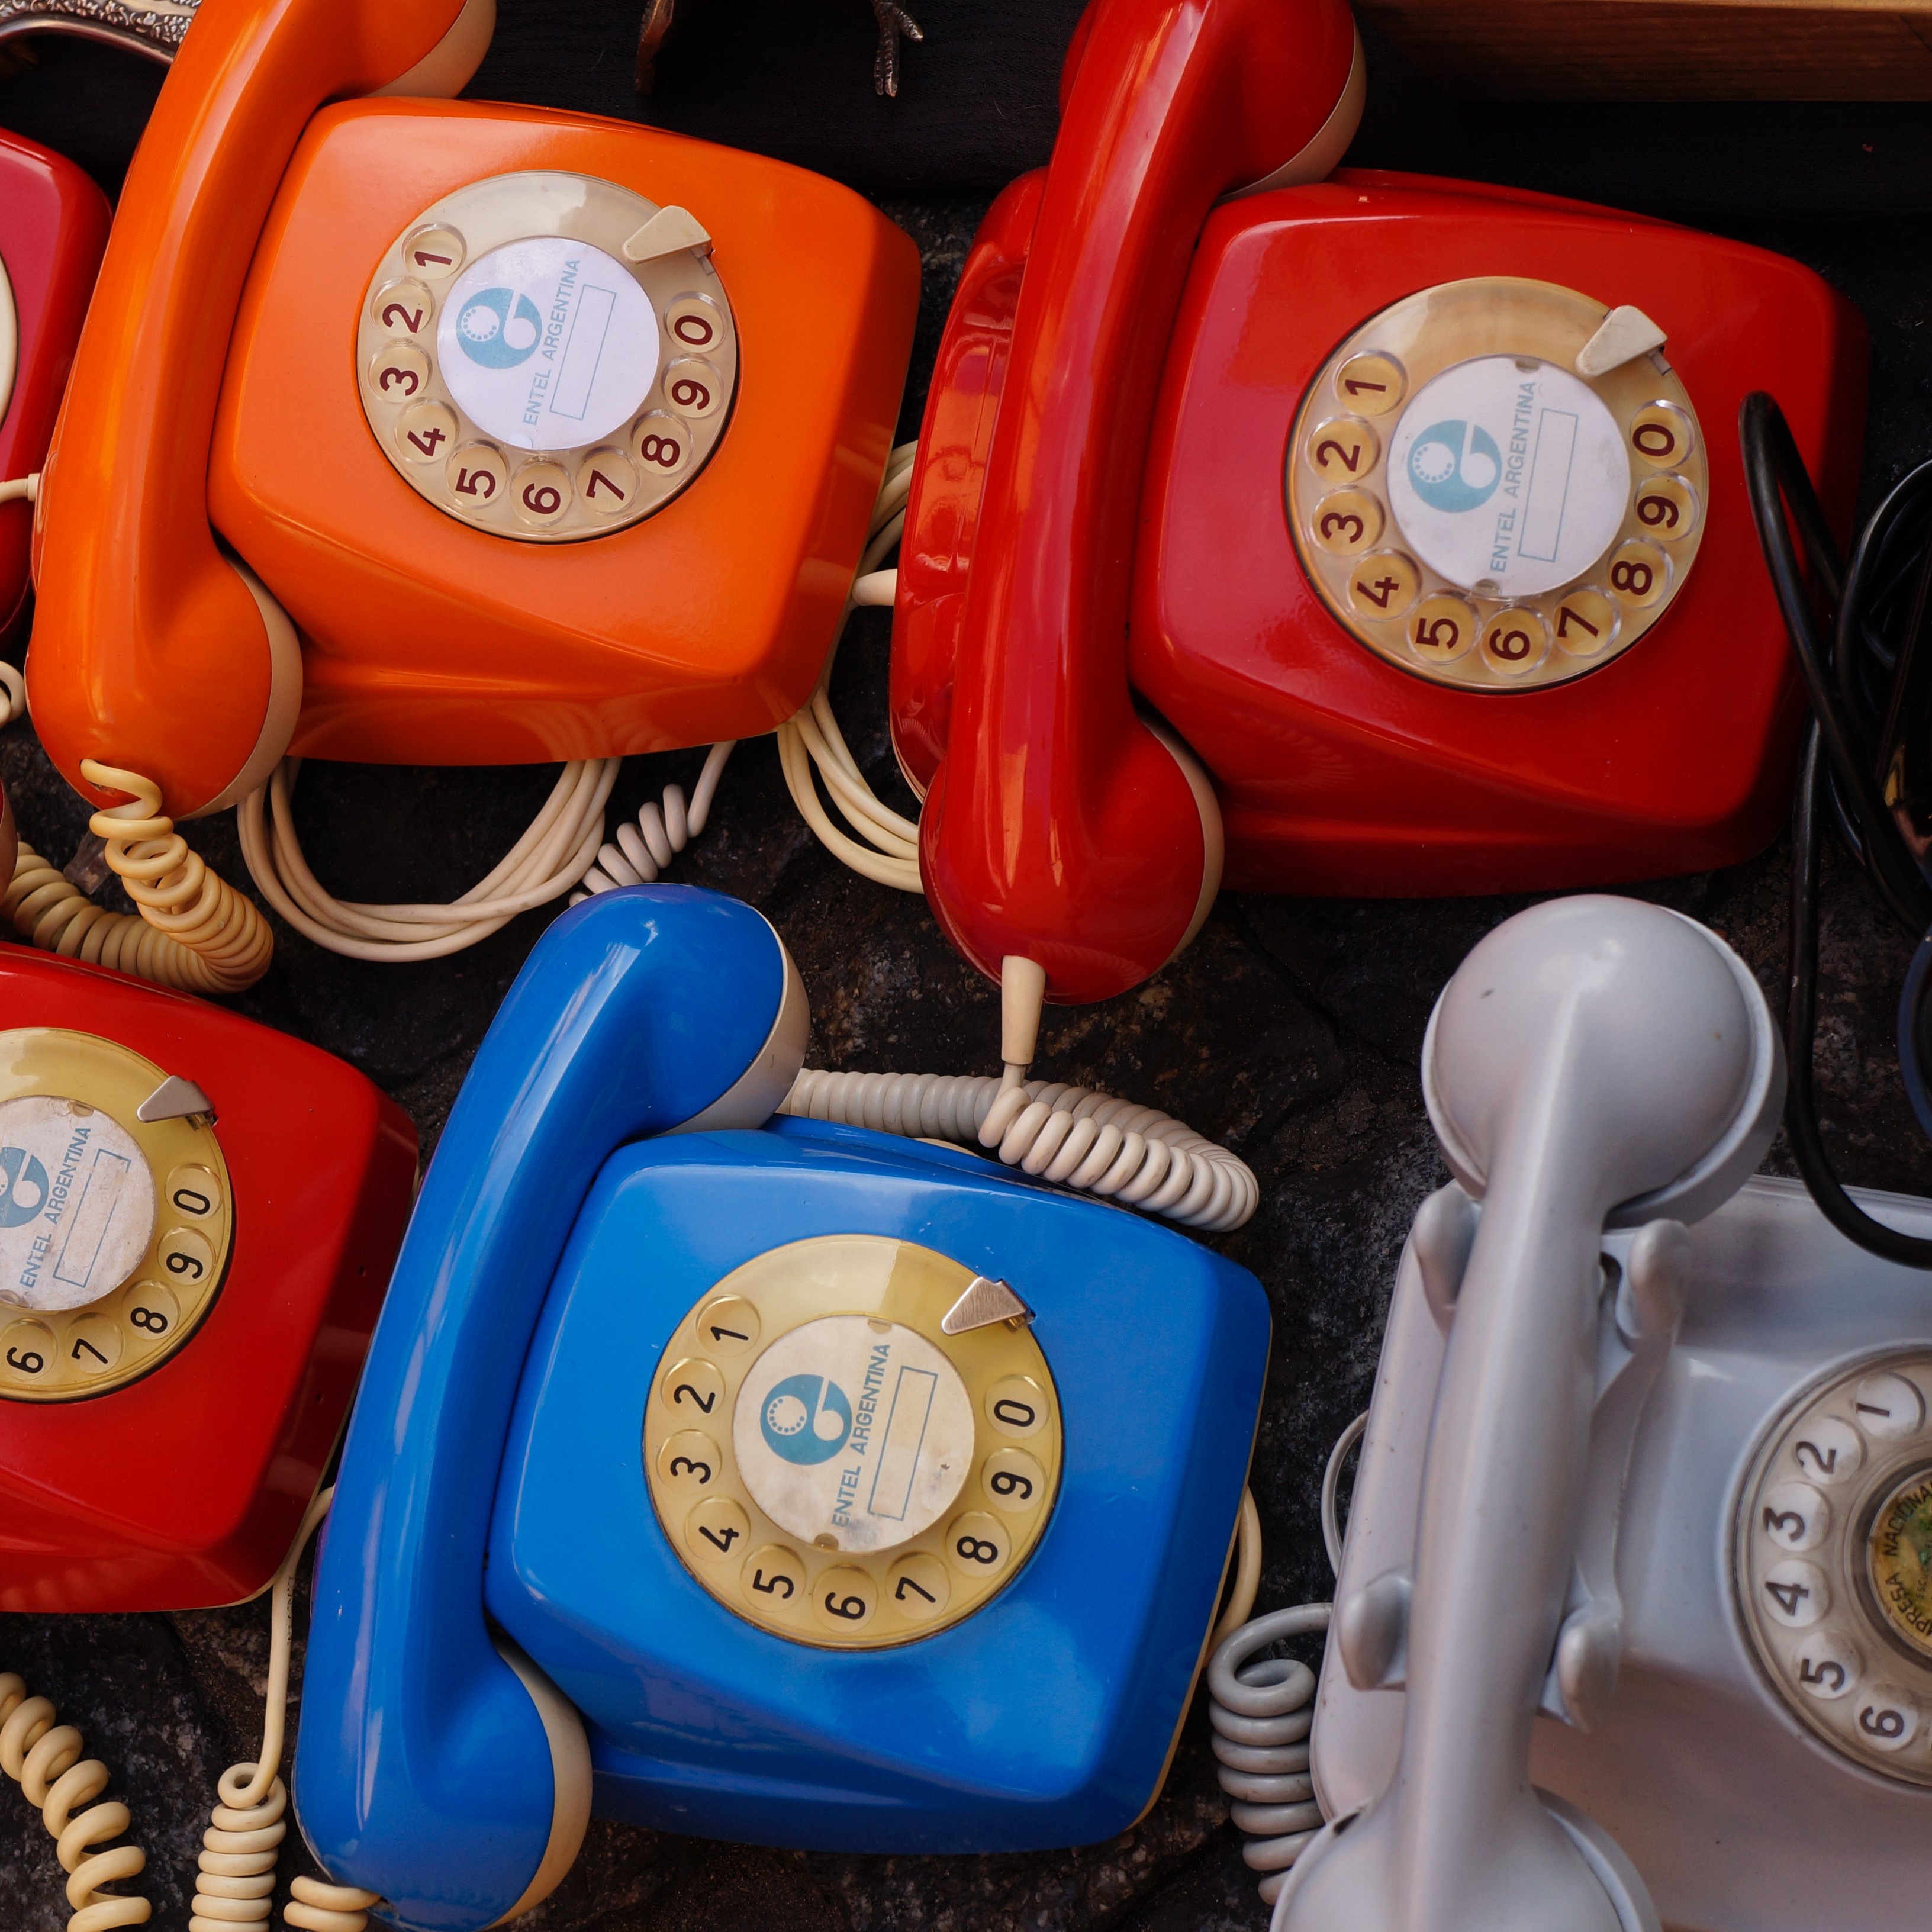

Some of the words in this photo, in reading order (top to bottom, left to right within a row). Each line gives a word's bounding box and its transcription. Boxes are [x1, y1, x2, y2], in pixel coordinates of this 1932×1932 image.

[414, 251, 452, 266] 1
[382, 304, 423, 333] 2
[674, 315, 713, 345] 0
[523, 369, 551, 425] ENTEL
[540, 259, 580, 360] ARGENTINA
[380, 368, 418, 396] 3
[672, 379, 710, 410] 9
[1345, 379, 1386, 395] 1
[407, 428, 446, 456] 4
[642, 434, 680, 467] 8
[1632, 424, 1674, 456] 0
[1316, 440, 1360, 472] 2
[456, 468, 495, 498] 5
[586, 470, 624, 500] 7
[1490, 507, 1516, 572] ENTEL
[1503, 382, 1537, 498] ARGENTINA
[523, 483, 561, 514] 6
[1637, 496, 1679, 528] 9
[1321, 513, 1363, 543] 3
[1357, 577, 1399, 608] 4
[1611, 561, 1653, 595] 8
[1415, 618, 1458, 649] 5
[1557, 607, 1598, 638] 7
[1489, 628, 1530, 660] 6
[20, 1233, 52, 1289] ENTEL
[45, 1127, 91, 1225] ARGENTINA
[173, 1189, 210, 1215] 0
[166, 1252, 203, 1279] 9
[130, 1307, 168, 1333] 8
[710, 1326, 748, 1341] 1
[7, 1347, 43, 1373] 6
[72, 1339, 108, 1364] 7
[674, 1384, 715, 1413] 2
[994, 1400, 1035, 1427] 0
[1854, 1403, 1889, 1416] 1
[832, 1465, 861, 1527] ENTEL
[849, 1344, 891, 1455] ARGENTINA
[670, 1457, 711, 1484] 3
[1794, 1441, 1836, 1473] 2
[991, 1471, 1032, 1499] 9
[1763, 1508, 1805, 1542] 3
[1883, 1482, 1932, 1556] NACIONA
[699, 1527, 739, 1552] 4
[957, 1536, 998, 1564] 8
[753, 1569, 794, 1599] 5
[895, 1577, 935, 1602] 7
[1765, 1582, 1808, 1615] 4
[825, 1592, 865, 1619] 6
[1799, 1659, 1844, 1690] 5
[1860, 1706, 1904, 1738] 6
